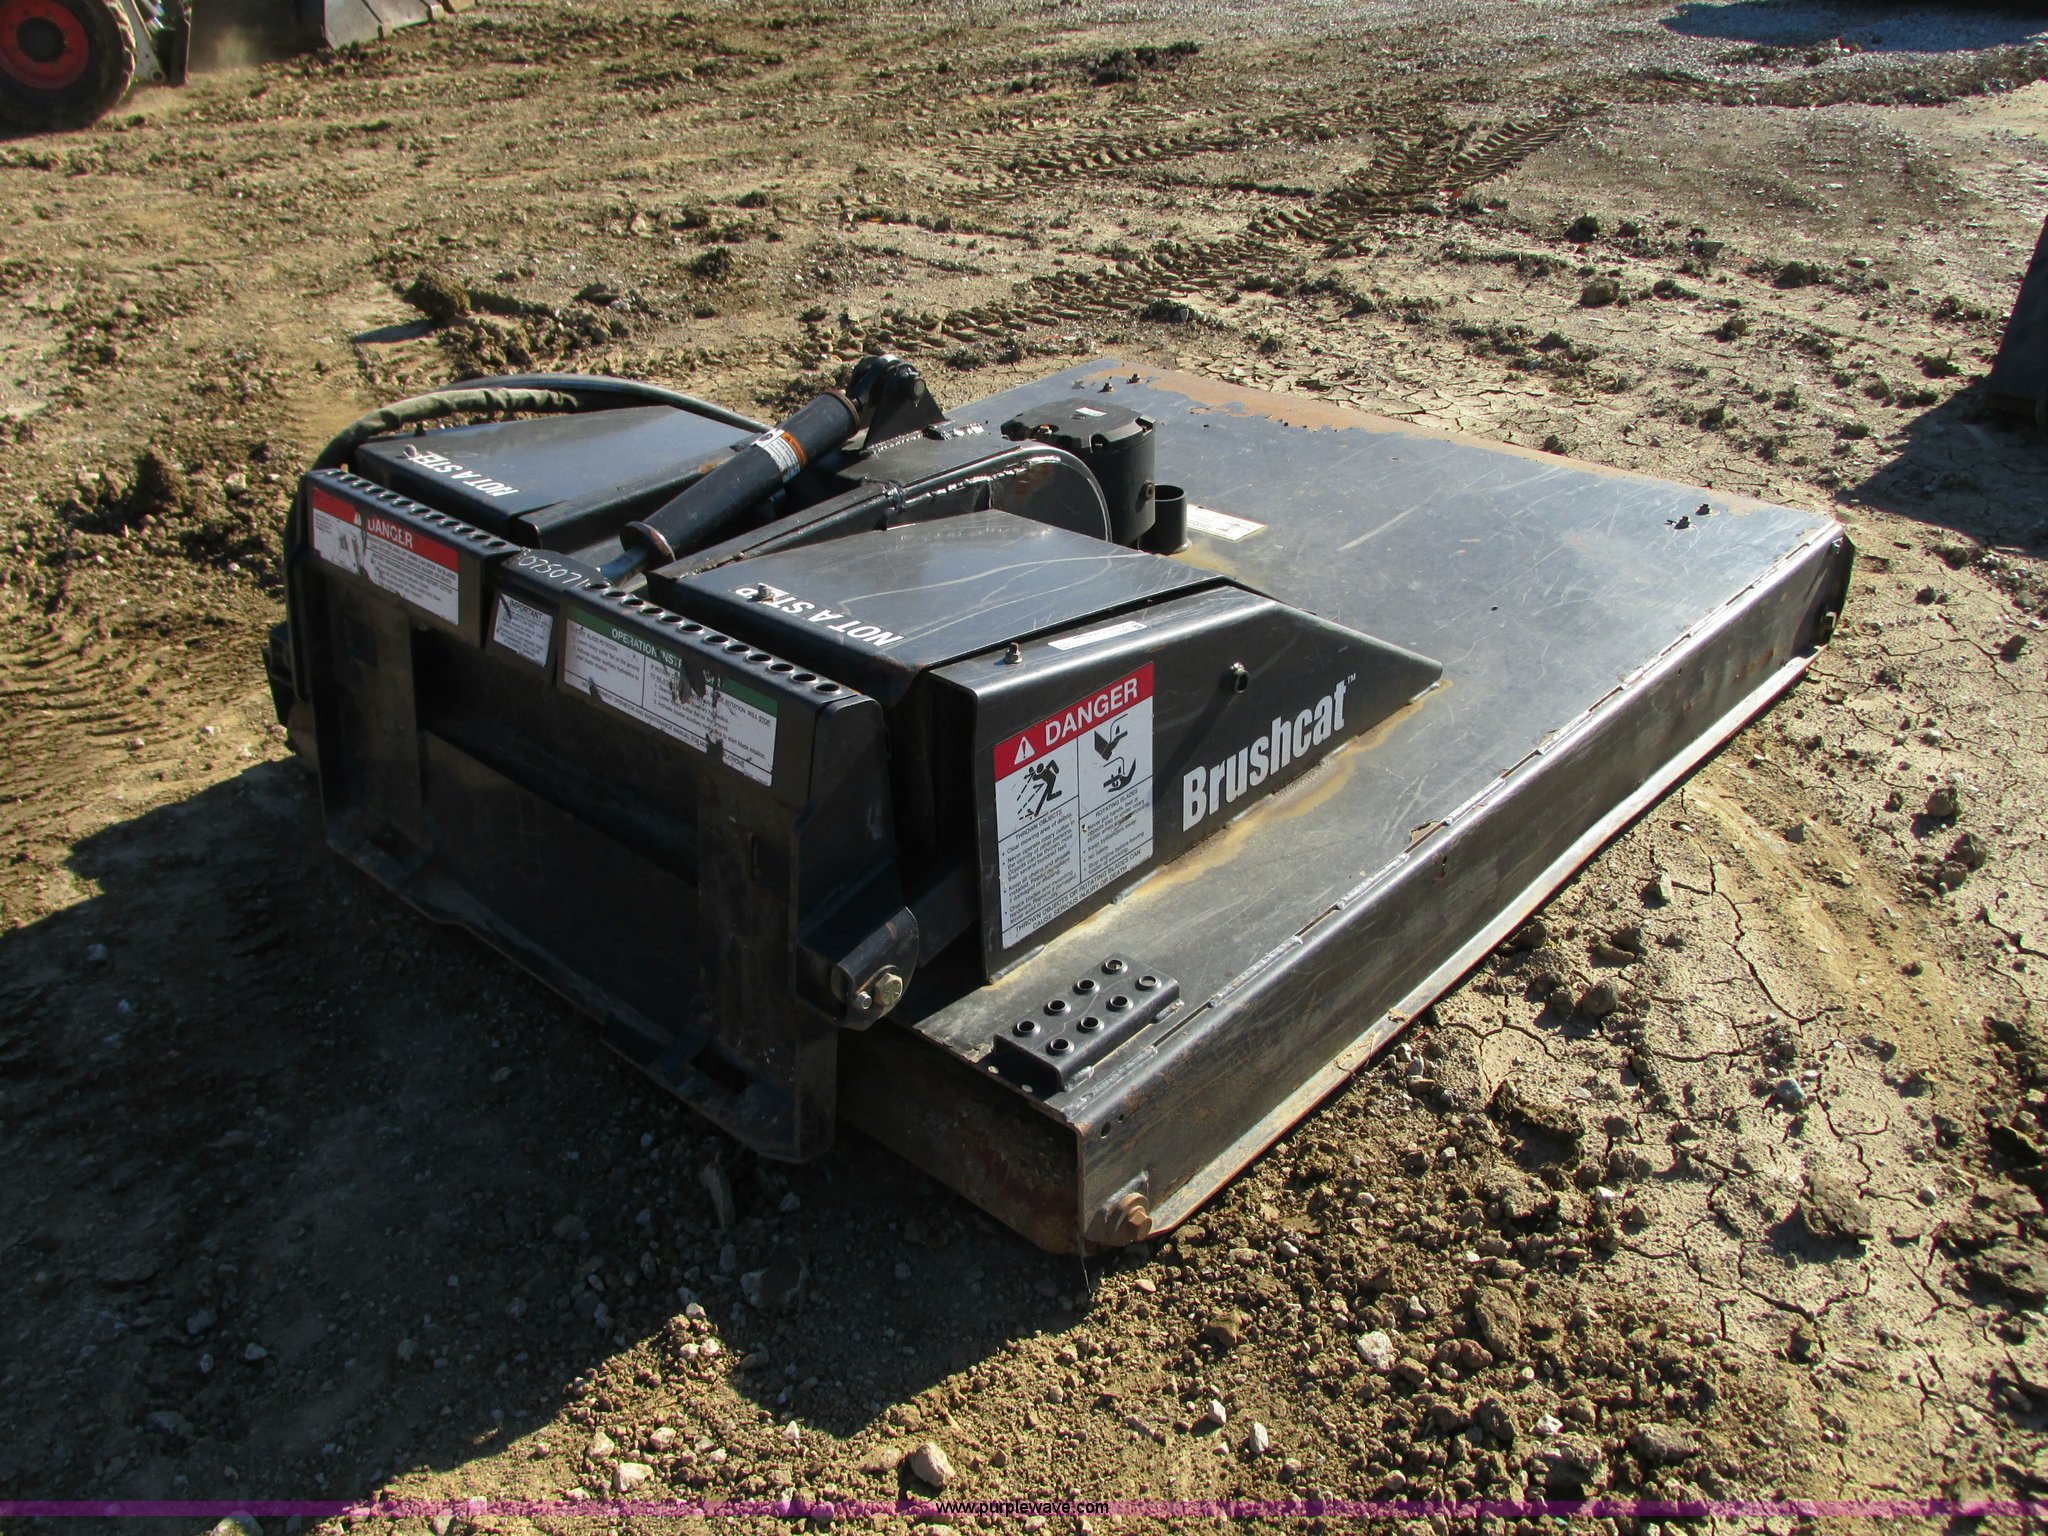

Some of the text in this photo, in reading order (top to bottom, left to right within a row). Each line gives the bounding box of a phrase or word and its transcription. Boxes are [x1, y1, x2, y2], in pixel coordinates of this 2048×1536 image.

[451, 470, 482, 479] A
[462, 478, 519, 496] NOT
[367, 517, 413, 549] DANGER
[509, 599, 542, 620] IMPORTANT
[807, 609, 845, 622] A
[611, 627, 657, 657] OPERATION
[826, 620, 904, 646] NOT
[1045, 675, 1137, 747] DANGER
[1182, 679, 1347, 832] Brushcat
[1095, 799, 1119, 818] ROTATING
[1120, 787, 1137, 803] BLADES
[1015, 808, 1062, 841] THROWN OBJECTS
[1016, 911, 1041, 932] THROWN
[1042, 894, 1068, 916] OBJECTS
[1069, 888, 1077, 898] OR
[1078, 870, 1106, 892] ROTATING
[1107, 856, 1128, 874] BLADES
[1129, 848, 1140, 860] CAN
[1032, 864, 1127, 930] CAUSE SERIOUS INJURY OR DEATH
